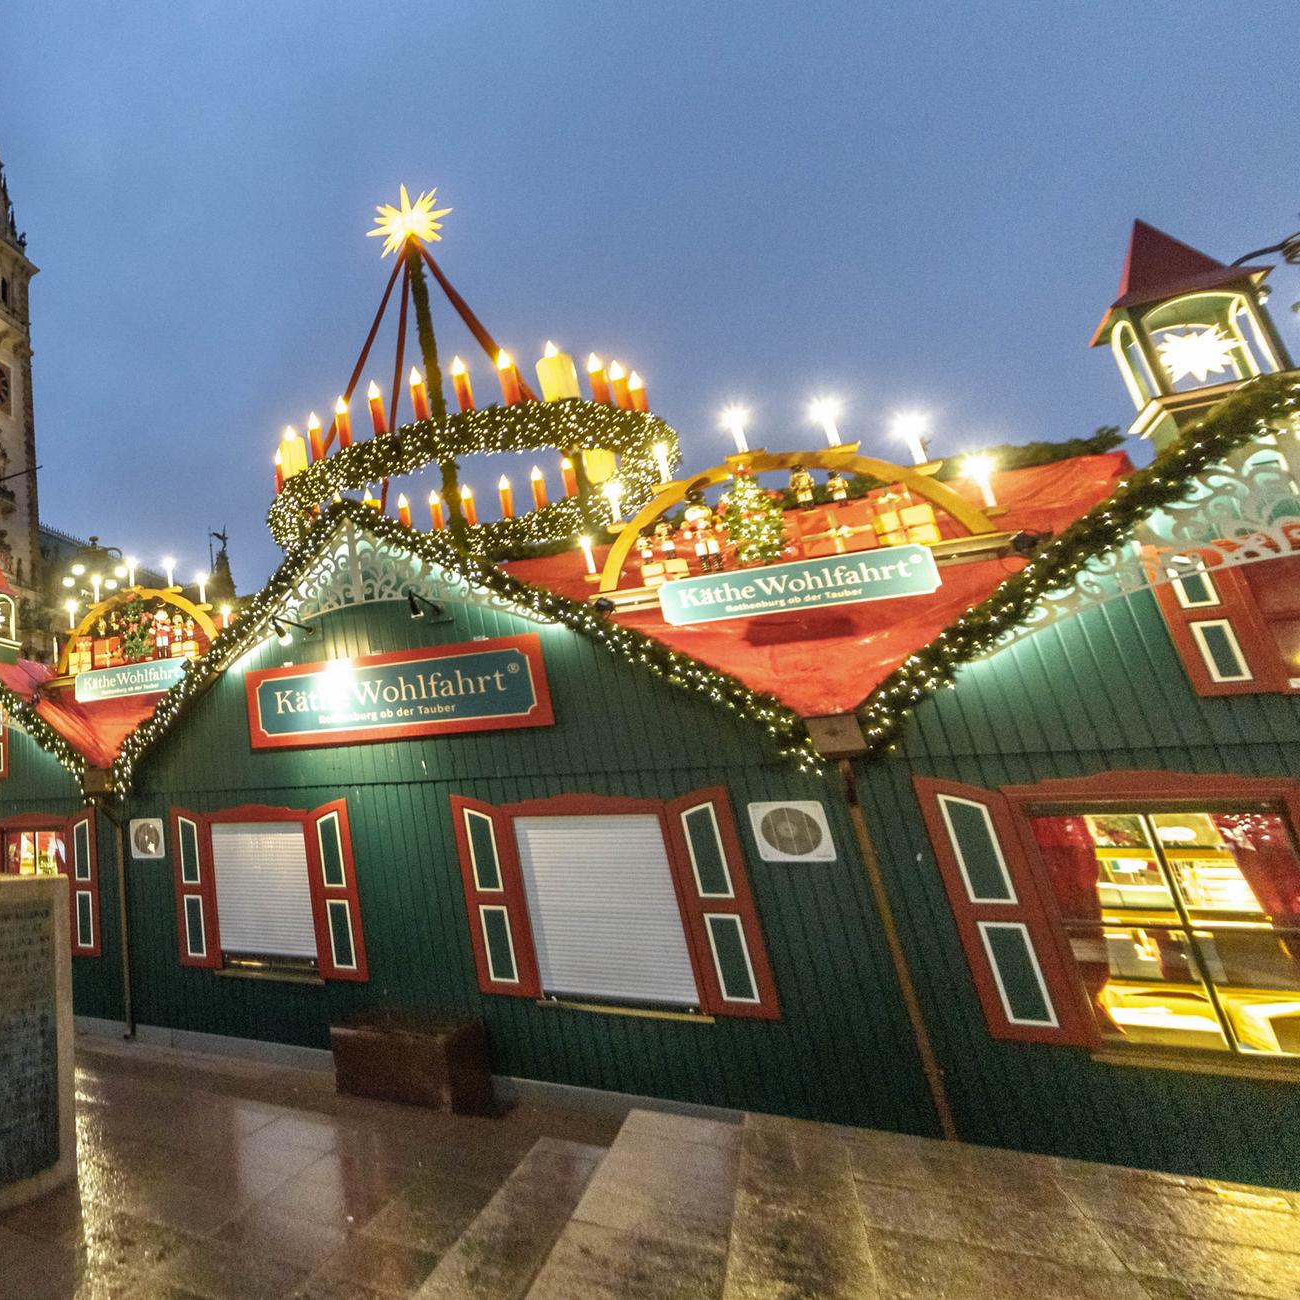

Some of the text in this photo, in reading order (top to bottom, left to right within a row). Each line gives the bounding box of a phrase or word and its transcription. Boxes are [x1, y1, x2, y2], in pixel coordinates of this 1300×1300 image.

[678, 582, 756, 609] Käthe
[725, 588, 863, 613] Rothenburg ob der Tauber
[274, 688, 351, 714] Kät
[380, 708, 394, 719] ob
[396, 706, 414, 717] der
[417, 703, 456, 714] Tauber
